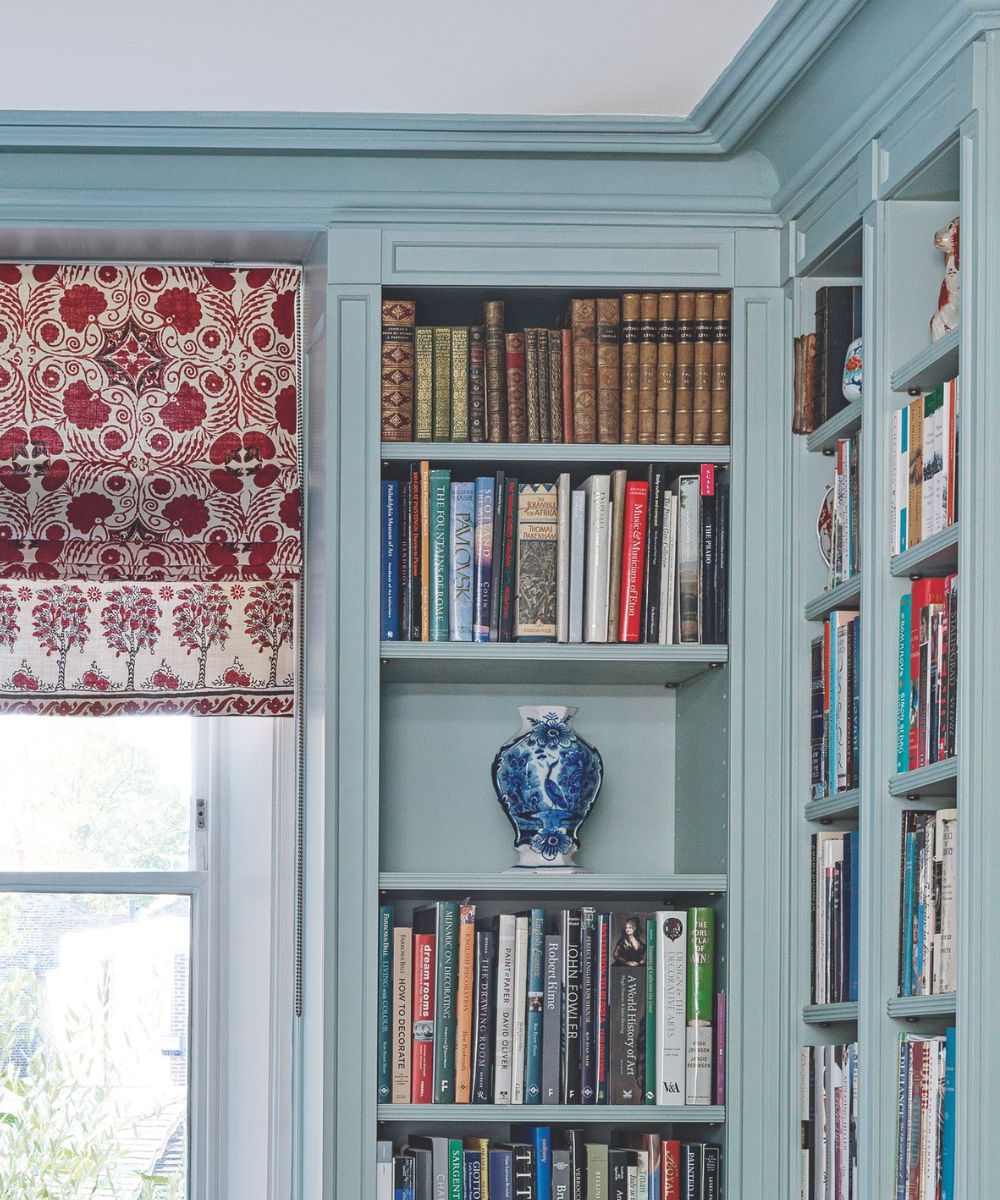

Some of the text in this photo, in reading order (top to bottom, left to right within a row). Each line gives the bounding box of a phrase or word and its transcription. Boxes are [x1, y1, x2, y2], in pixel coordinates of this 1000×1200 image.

[482, 489, 491, 558] SCOTLAND
[436, 486, 445, 622] THE FOUNTAINS OF ROME
[455, 513, 471, 600] PAVLOVSK
[628, 504, 643, 616] Music & Musicians of Eton
[423, 945, 432, 1017] dream rooms
[444, 951, 452, 964] ON
[547, 943, 558, 1010] Robert Kime
[398, 1004, 405, 1016] TO
[443, 967, 452, 1018] DECORATING
[480, 984, 488, 1032] DRAWING
[568, 944, 578, 1039] JOHN FOWLER
[627, 984, 635, 1008] World
[668, 952, 676, 1037] DECORATIVE ARTS
[625, 1014, 635, 1044] History
[627, 1049, 635, 1058] of
[473, 1162, 481, 1199] GIOTTO
[639, 1170, 647, 1193] Titian
[687, 1153, 696, 1191] PAINTED
